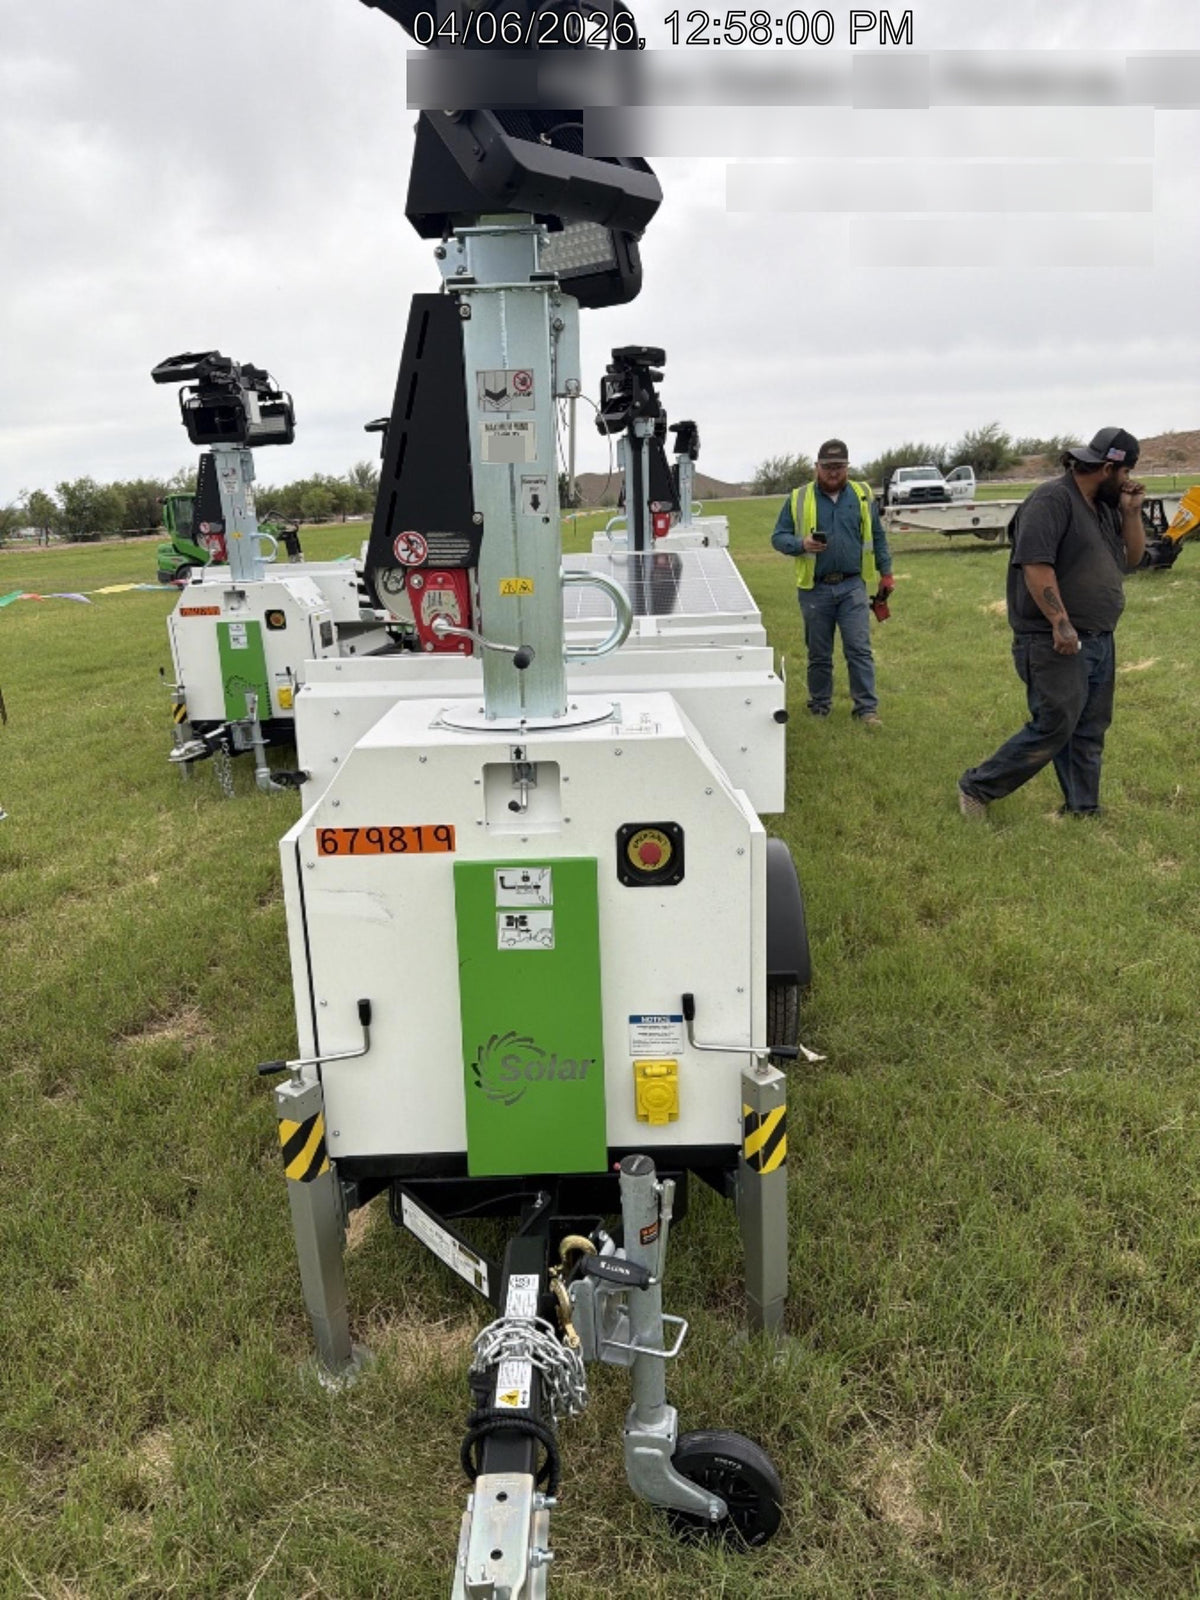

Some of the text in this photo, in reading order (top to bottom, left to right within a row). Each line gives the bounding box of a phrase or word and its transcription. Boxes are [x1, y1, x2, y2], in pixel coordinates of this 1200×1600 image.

[320, 825, 452, 854] 679819
[641, 1016, 671, 1024] NOTICE
[499, 1054, 592, 1081] Solar
